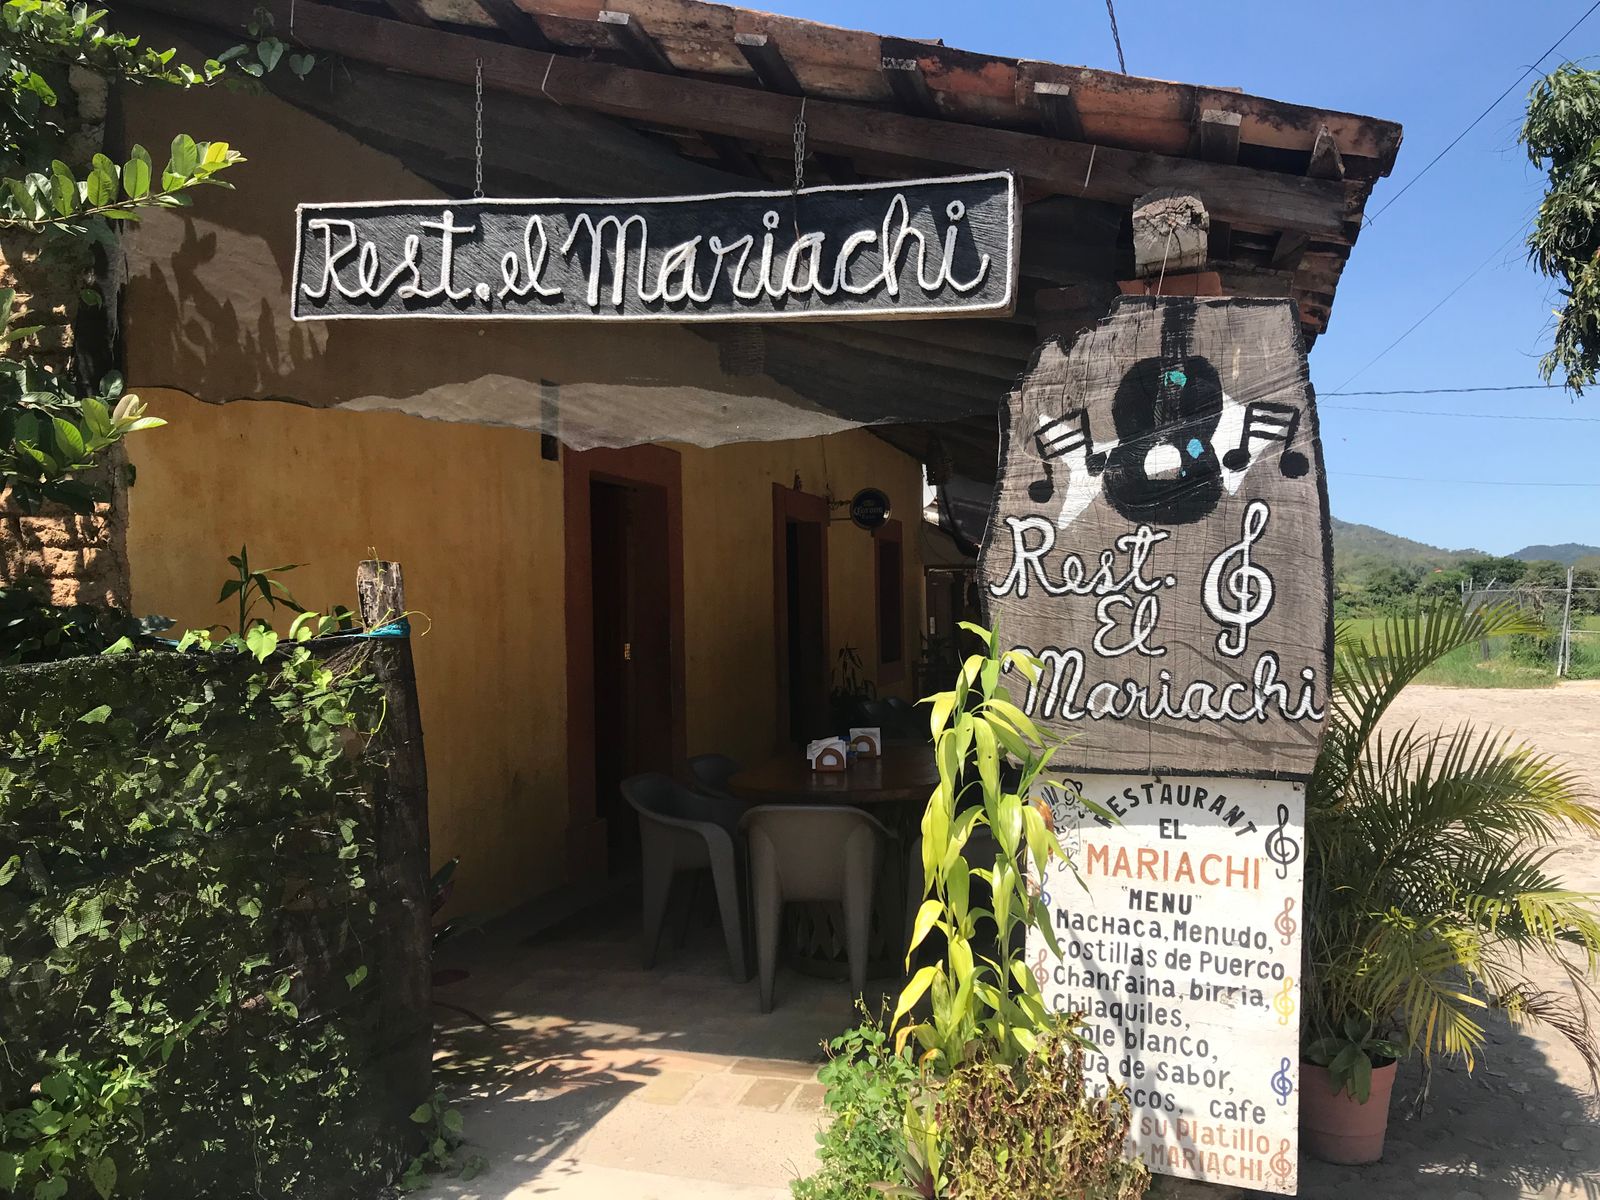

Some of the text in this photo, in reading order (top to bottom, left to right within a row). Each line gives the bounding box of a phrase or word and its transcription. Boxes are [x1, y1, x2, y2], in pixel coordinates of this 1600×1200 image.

[301, 194, 991, 306] Rest. el Mariachi
[989, 514, 1177, 598] Rest.
[1092, 593, 1168, 658] El
[1001, 645, 1326, 722] Mariachi
[1159, 818, 1187, 840] EL
[1173, 919, 1273, 953] Menudo,
[1165, 948, 1191, 971] de
[1200, 951, 1285, 981] Puerco
[1053, 965, 1270, 1012] Chanfaina, birria,
[1125, 1027, 1218, 1063] blanco,
[1119, 1055, 1146, 1080] de
[1210, 1099, 1266, 1124] cafe
